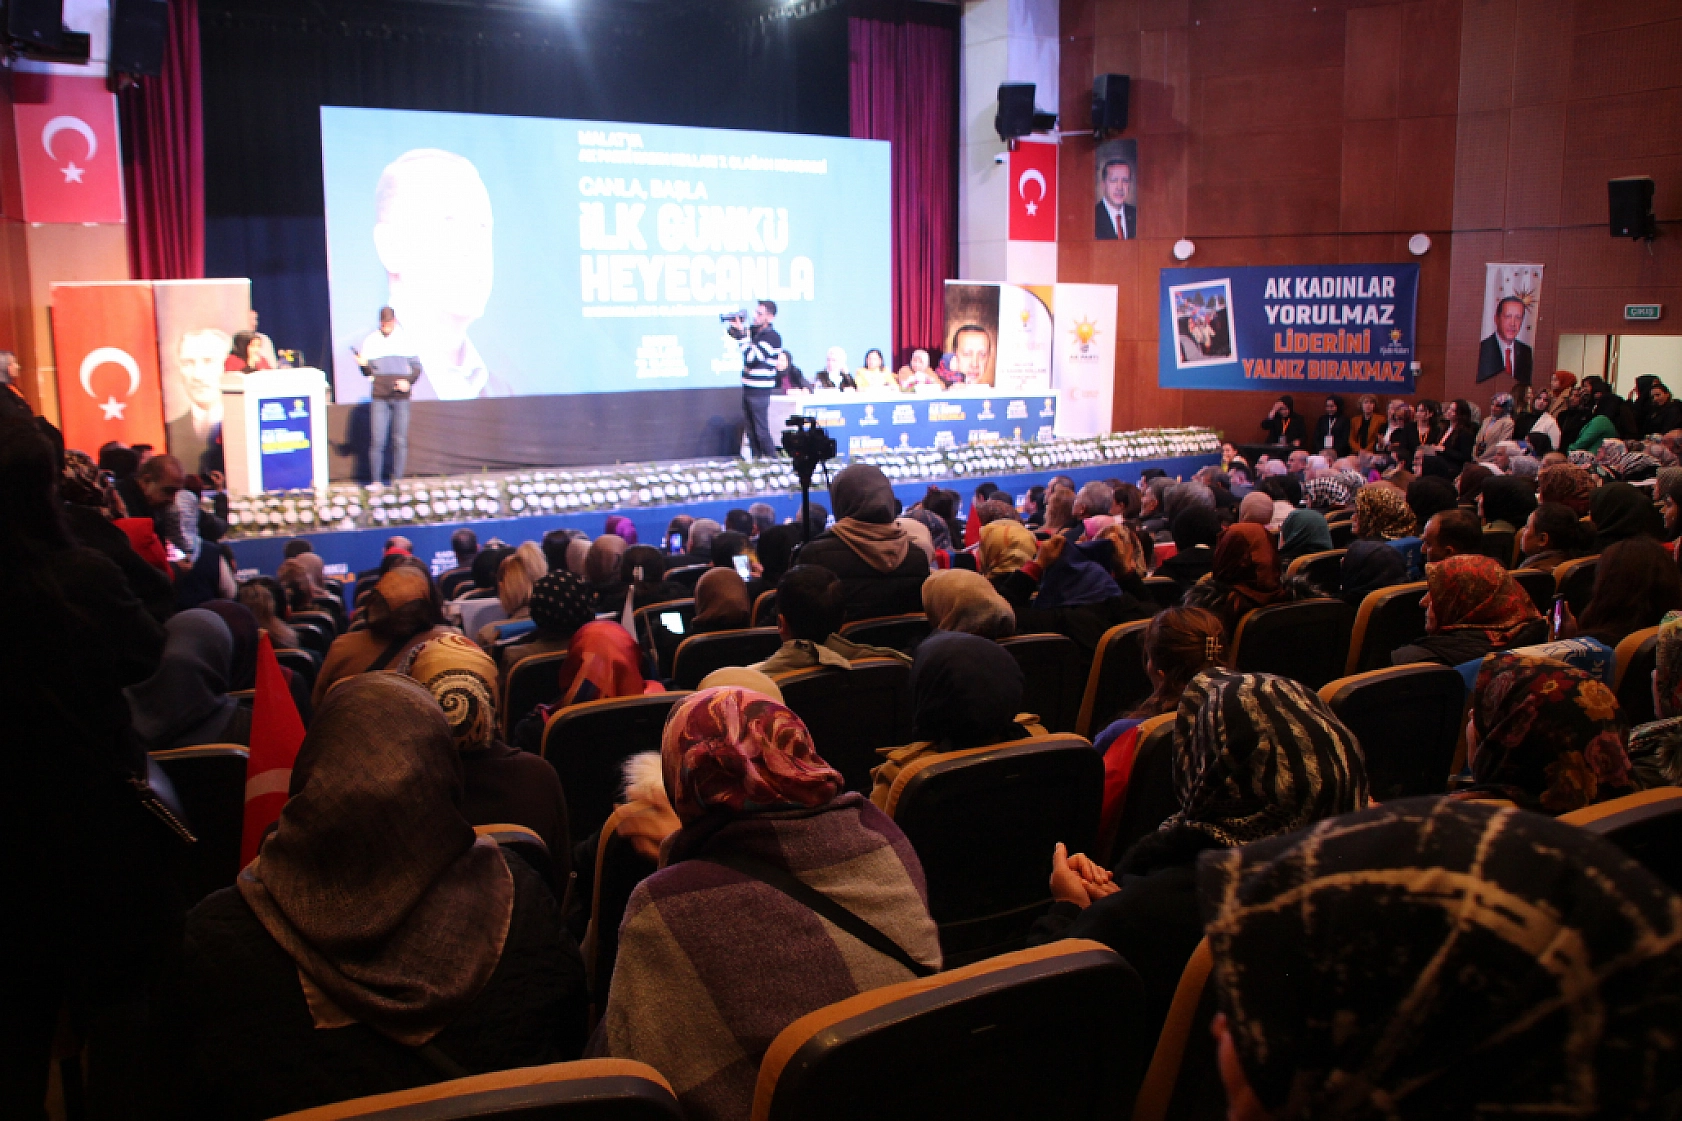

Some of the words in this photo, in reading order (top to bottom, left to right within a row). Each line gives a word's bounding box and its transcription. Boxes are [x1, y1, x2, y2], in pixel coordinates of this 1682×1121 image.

[650, 179, 708, 202] BAŞLA
[579, 202, 648, 250] İLK
[657, 203, 788, 253] GÜNKÜ
[580, 254, 815, 301] HEYECANLA
[1264, 277, 1291, 299] AK
[1295, 276, 1395, 298] KADINLAR
[1264, 304, 1395, 326] YORULMAZ
[1273, 328, 1372, 354] LİDERİNİ
[1241, 358, 1305, 380] YALNIZ
[1307, 359, 1406, 382] BIRAKMAZ
